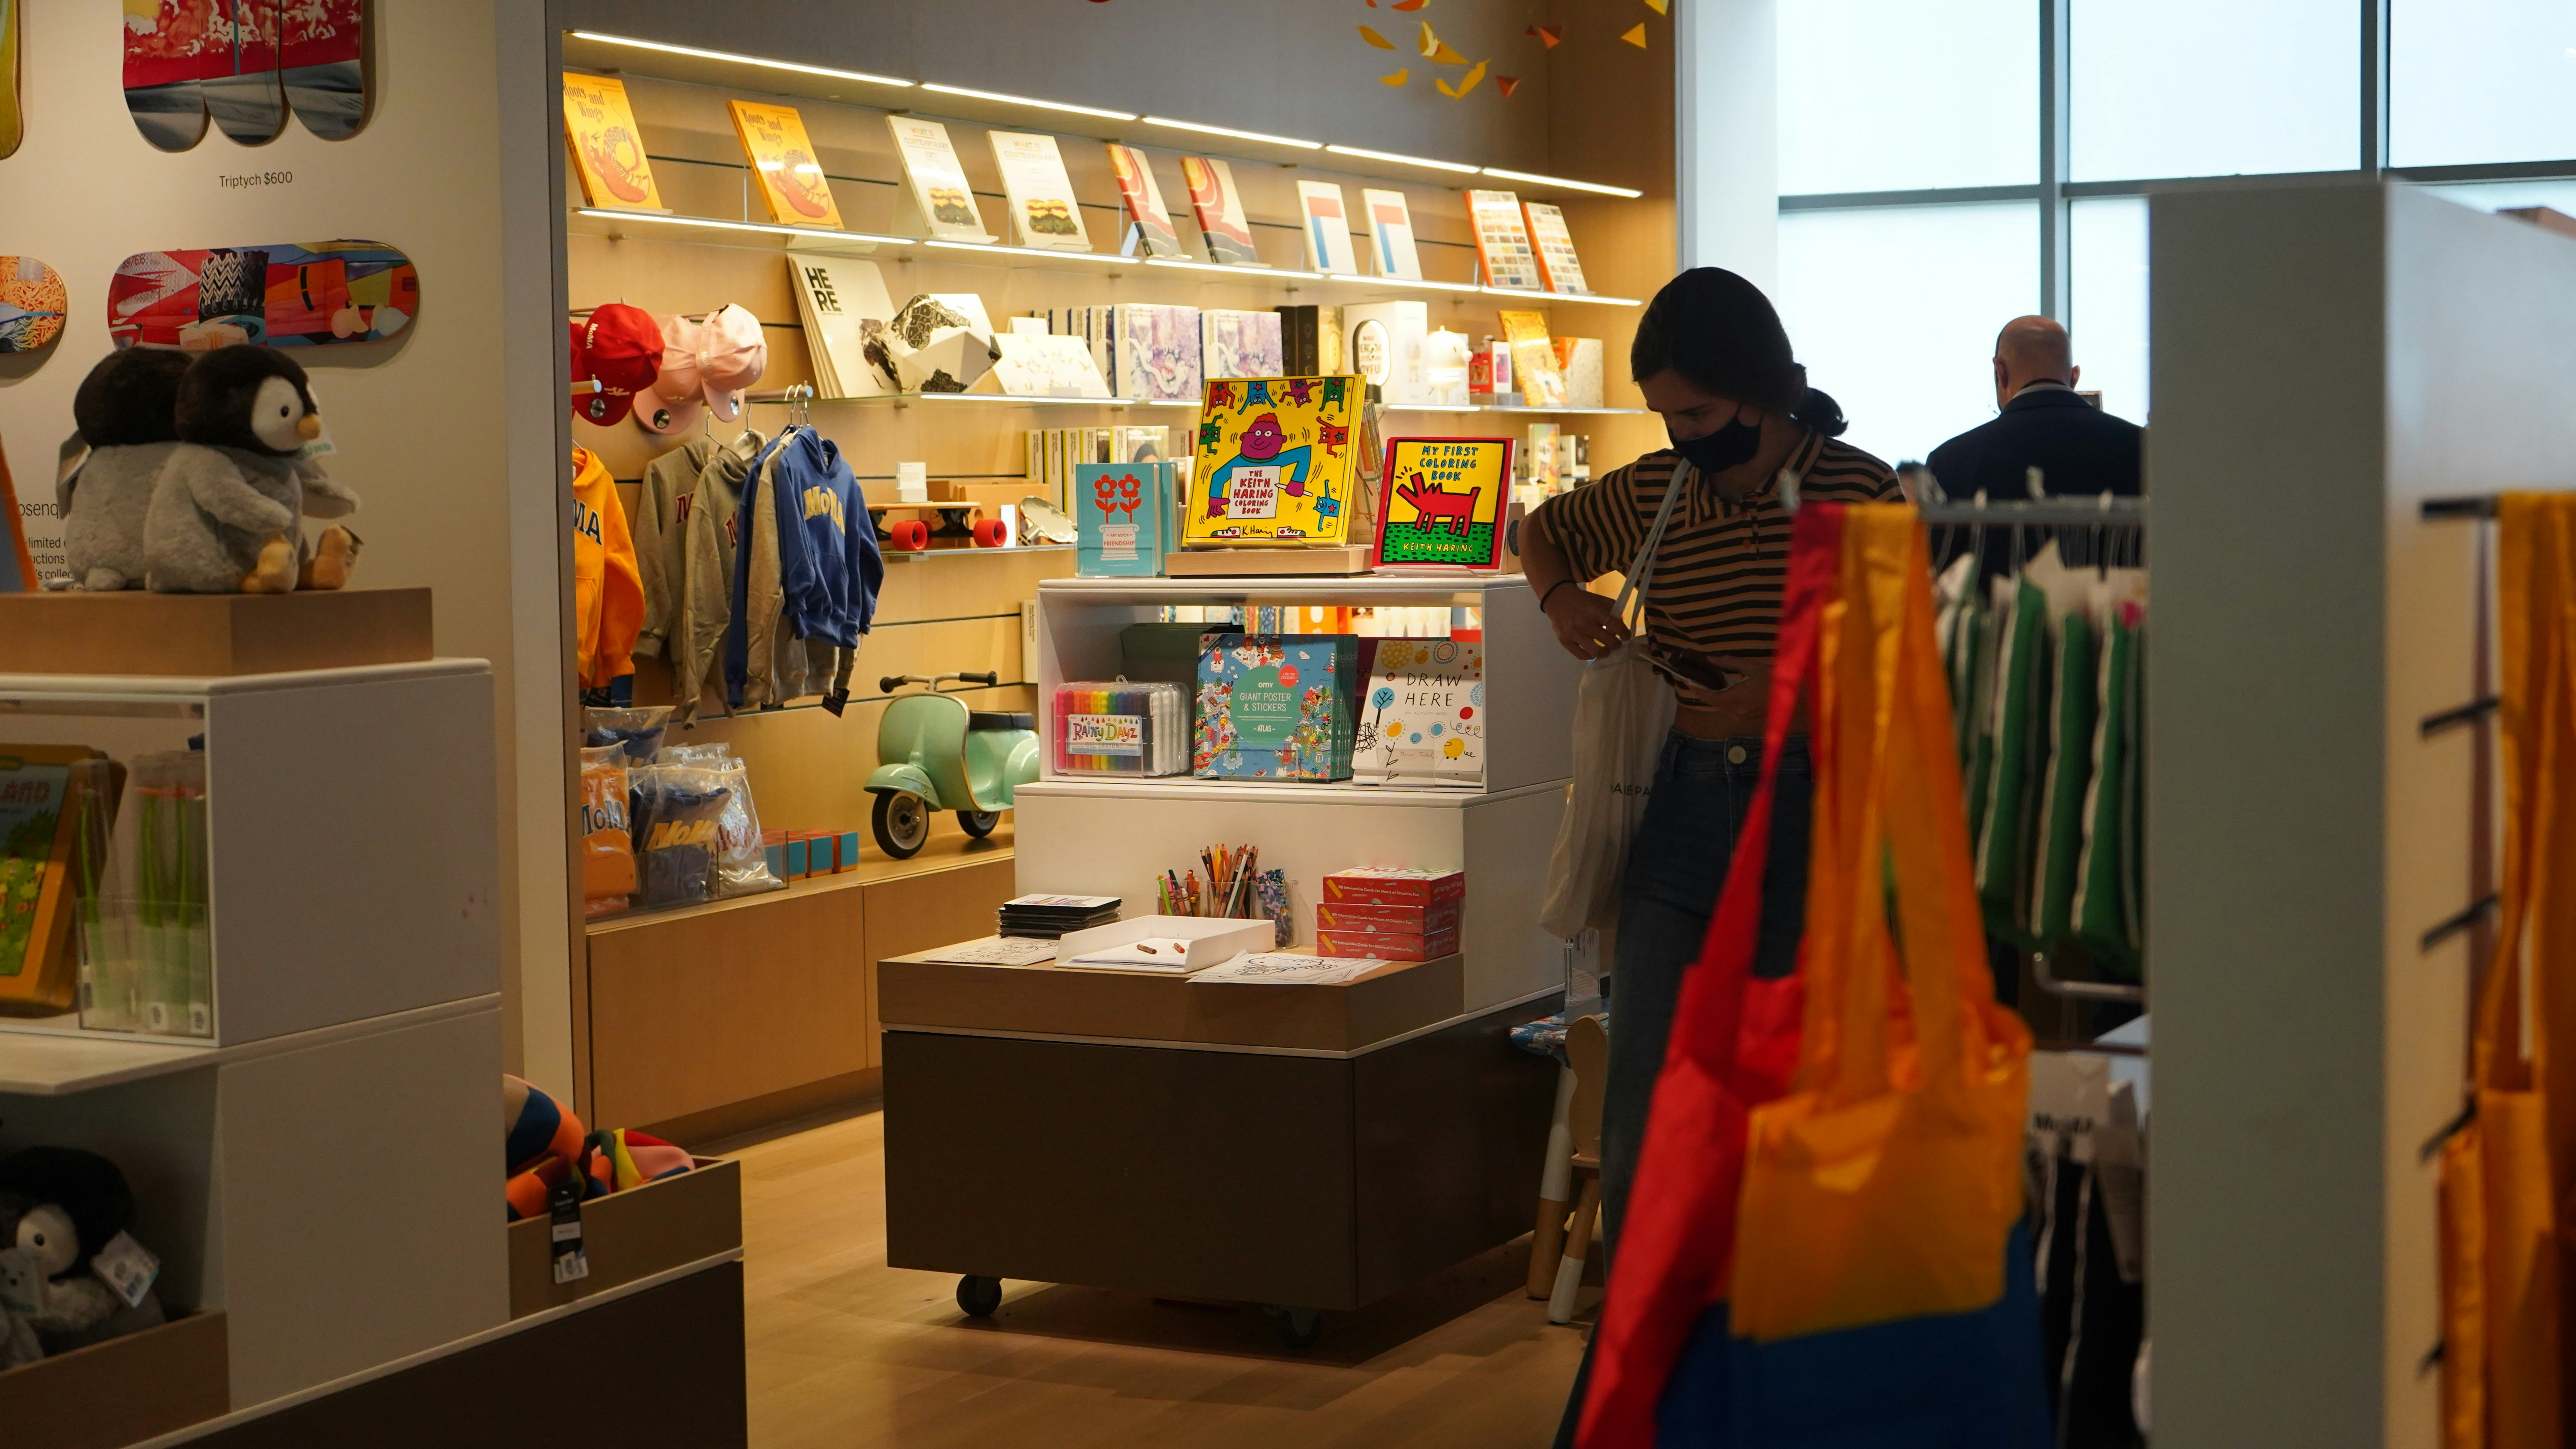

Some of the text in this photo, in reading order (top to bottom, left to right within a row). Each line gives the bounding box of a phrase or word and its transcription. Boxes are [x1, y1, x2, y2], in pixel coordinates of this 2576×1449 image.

[589, 90, 605, 105] and
[219, 171, 292, 189] Triptych $600
[805, 267, 833, 288] HE
[814, 290, 842, 311] RE
[586, 323, 598, 349] MoMA
[1422, 446, 1479, 456] MY FIRST
[1420, 458, 1476, 468] COLORING
[1431, 470, 1461, 481] BOOK
[1240, 478, 1270, 488] KEITH
[1233, 489, 1273, 499] HARING
[18, 503, 59, 520] osenq
[804, 485, 845, 536] MoMA
[1403, 543, 1473, 552] KEITH HARING
[33, 553, 65, 564] ctions
[45, 568, 73, 579] collec
[1407, 673, 1462, 686] DRAW
[1240, 692, 1291, 701] GIANT POSTER
[1405, 692, 1454, 706] HERE
[1244, 703, 1287, 712] & STICKERS
